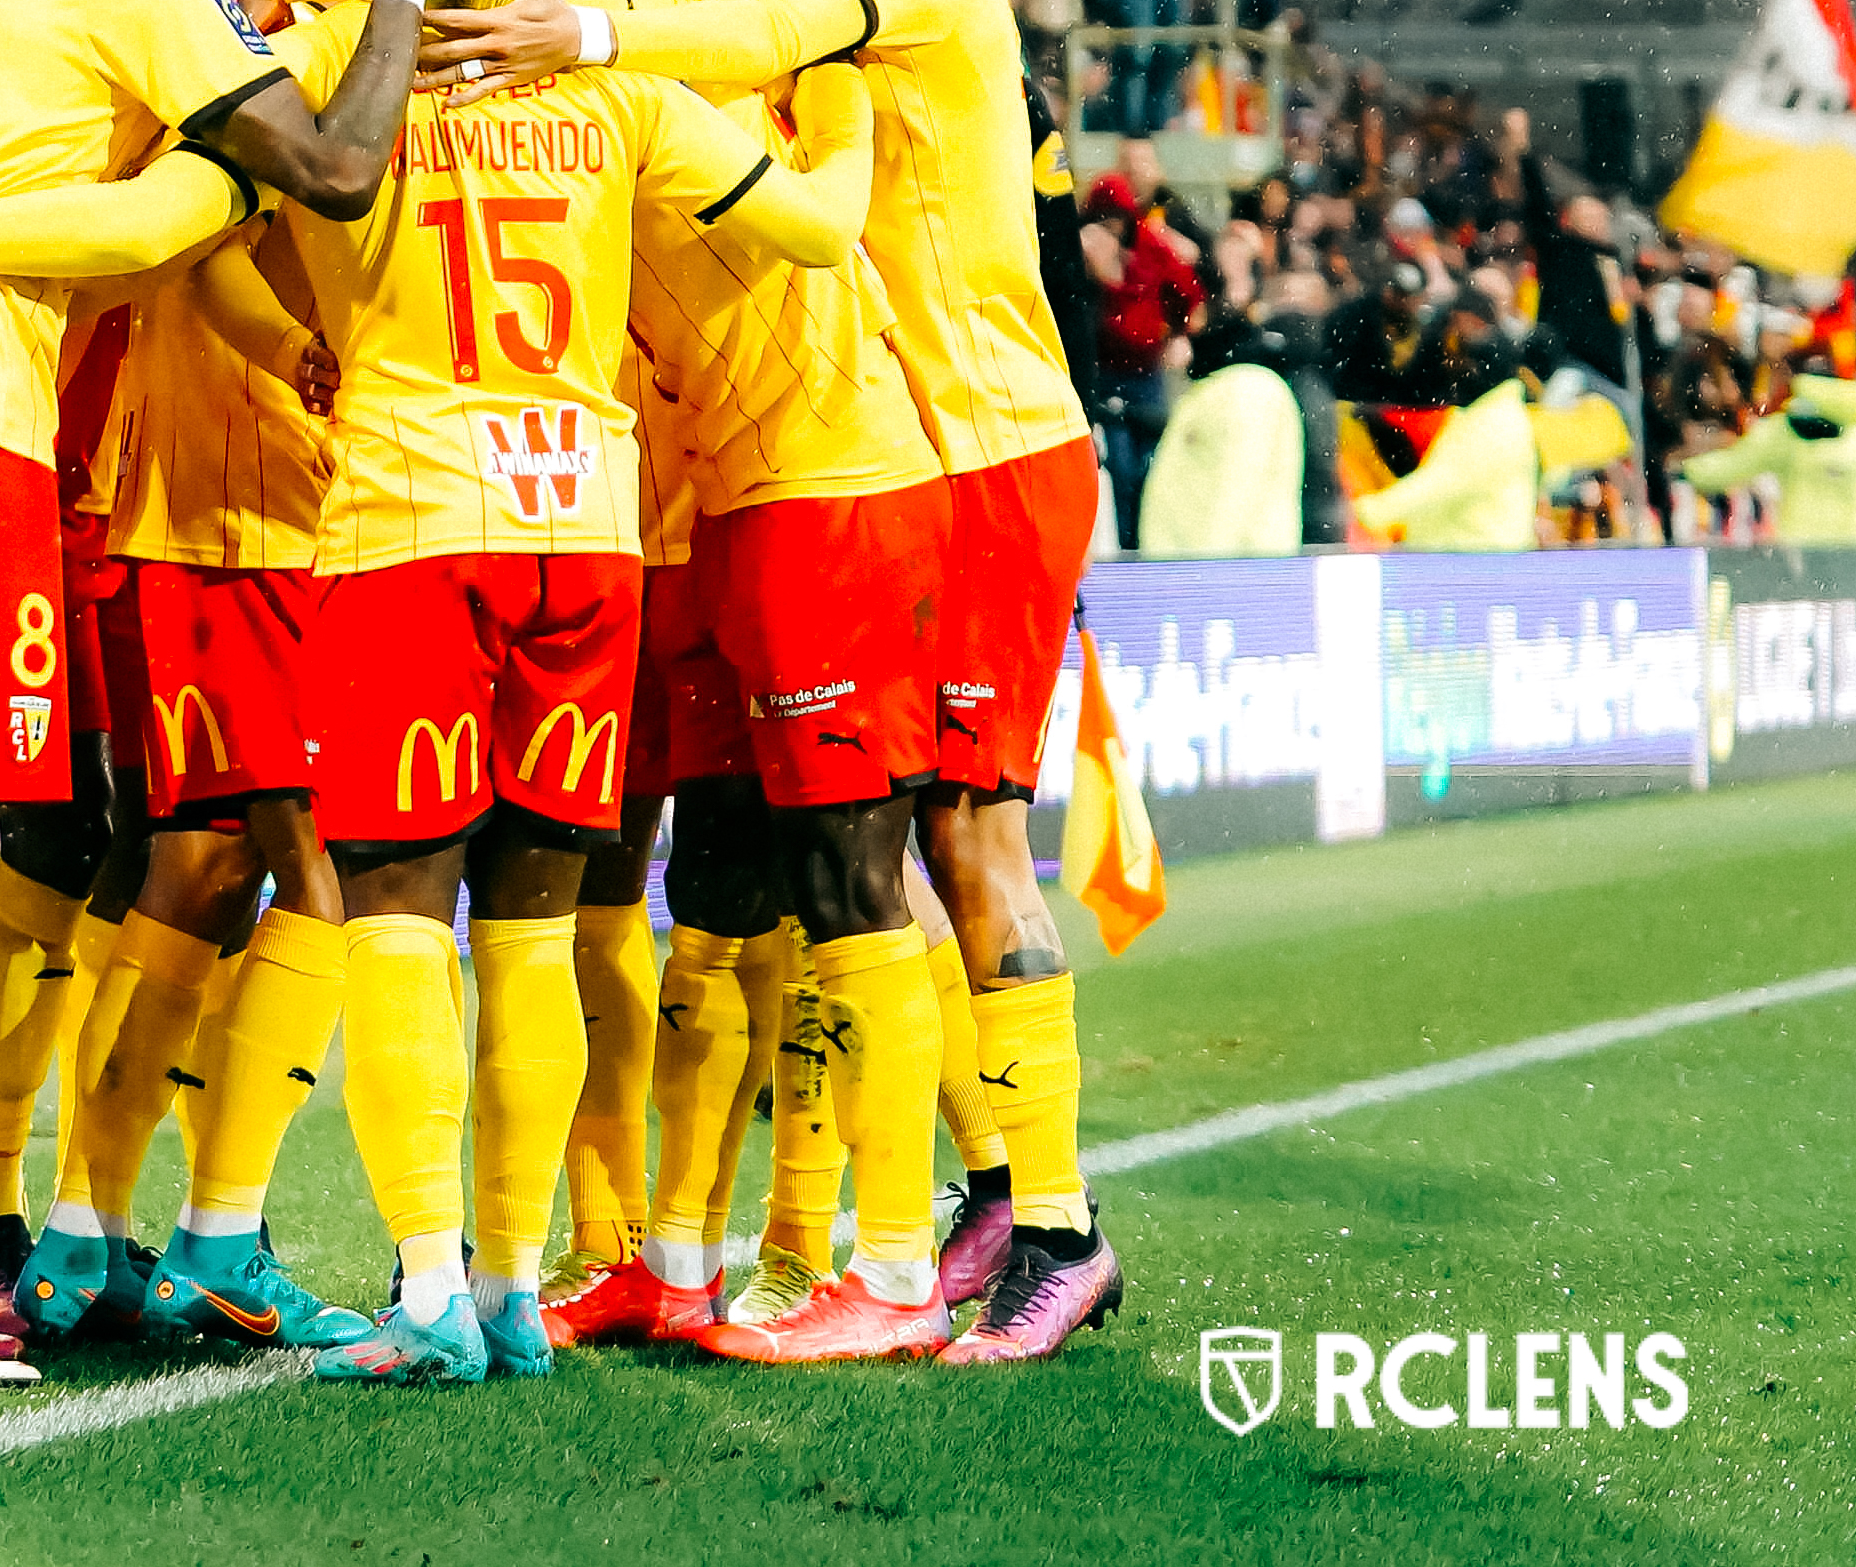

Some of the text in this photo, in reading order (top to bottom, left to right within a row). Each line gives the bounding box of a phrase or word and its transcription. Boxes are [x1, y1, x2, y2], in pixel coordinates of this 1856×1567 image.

[416, 197, 573, 383] 15
[10, 592, 57, 689] 8
[769, 678, 857, 706] Pas de Calais
[942, 680, 997, 699] de Calais
